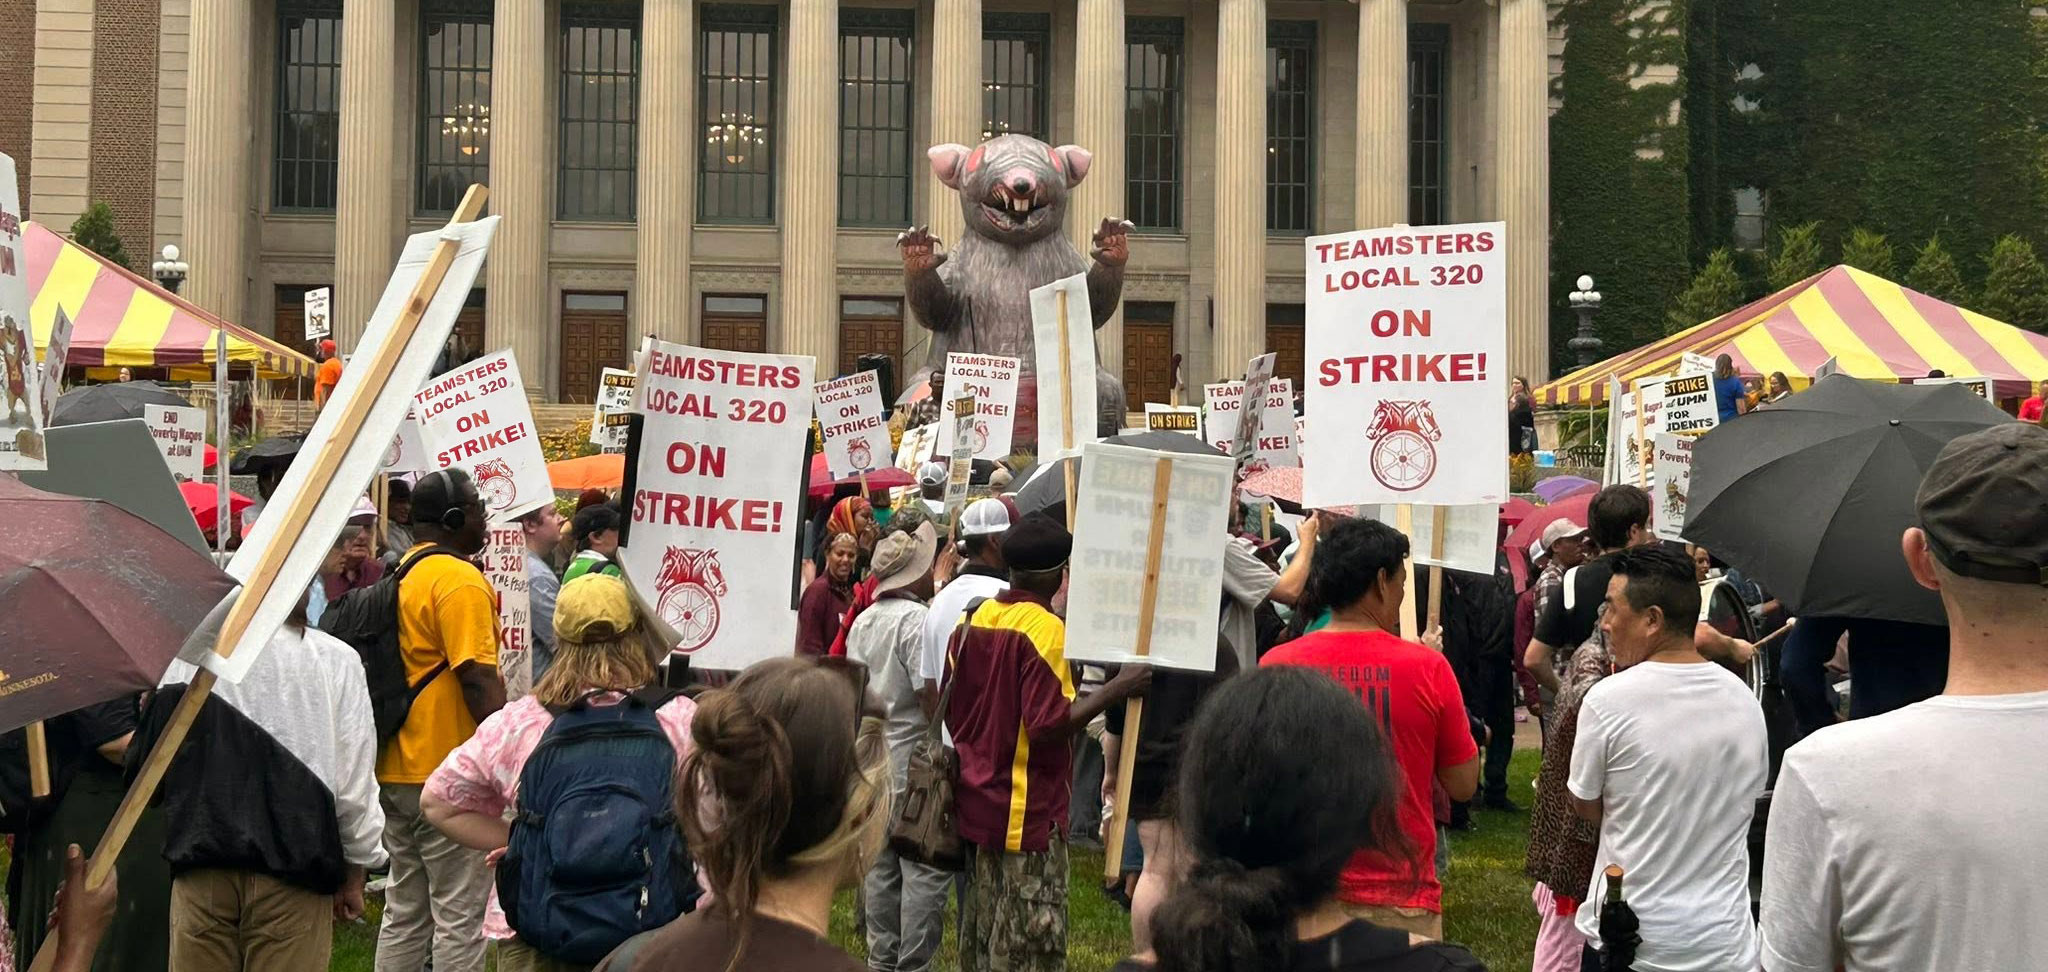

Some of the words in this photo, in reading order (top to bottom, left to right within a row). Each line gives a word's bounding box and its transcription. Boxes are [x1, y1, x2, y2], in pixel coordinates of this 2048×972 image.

[1315, 231, 1494, 263] TEAMSTERS
[1326, 266, 1419, 292] LOCAL
[1430, 264, 1484, 286] 320
[1370, 309, 1431, 337] ON
[950, 356, 1016, 369] TEAMSTERS
[1319, 352, 1487, 386] STRIKE!
[415, 358, 508, 405] TEAMSTERS
[814, 374, 874, 393] TEAMSTERS
[952, 368, 987, 378] LOCAL
[991, 371, 1011, 380] 320
[425, 390, 475, 419] LOCAL
[478, 377, 507, 396] 320
[820, 390, 852, 404] LOCAL
[855, 385, 872, 396] 320
[1208, 383, 1288, 397] TEAMRS
[647, 386, 717, 419] LOCAL
[728, 398, 786, 424] 320
[946, 400, 1009, 416] SIKE!
[1214, 401, 1240, 411] LOC
[1677, 393, 1708, 407] UMN
[164, 411, 178, 424] END
[840, 404, 860, 418] ON
[1668, 410, 1690, 420] FOR
[456, 409, 490, 433] ON
[825, 416, 881, 438] STRIKE!
[1151, 414, 1164, 428] ON
[1166, 414, 1196, 428] STRIKE
[179, 428, 202, 443] Wages
[437, 422, 527, 468] STRIKE!
[168, 444, 175, 456] at
[667, 442, 726, 478] ON
[633, 489, 783, 533] STRIKE!
[500, 556, 523, 572] 320
